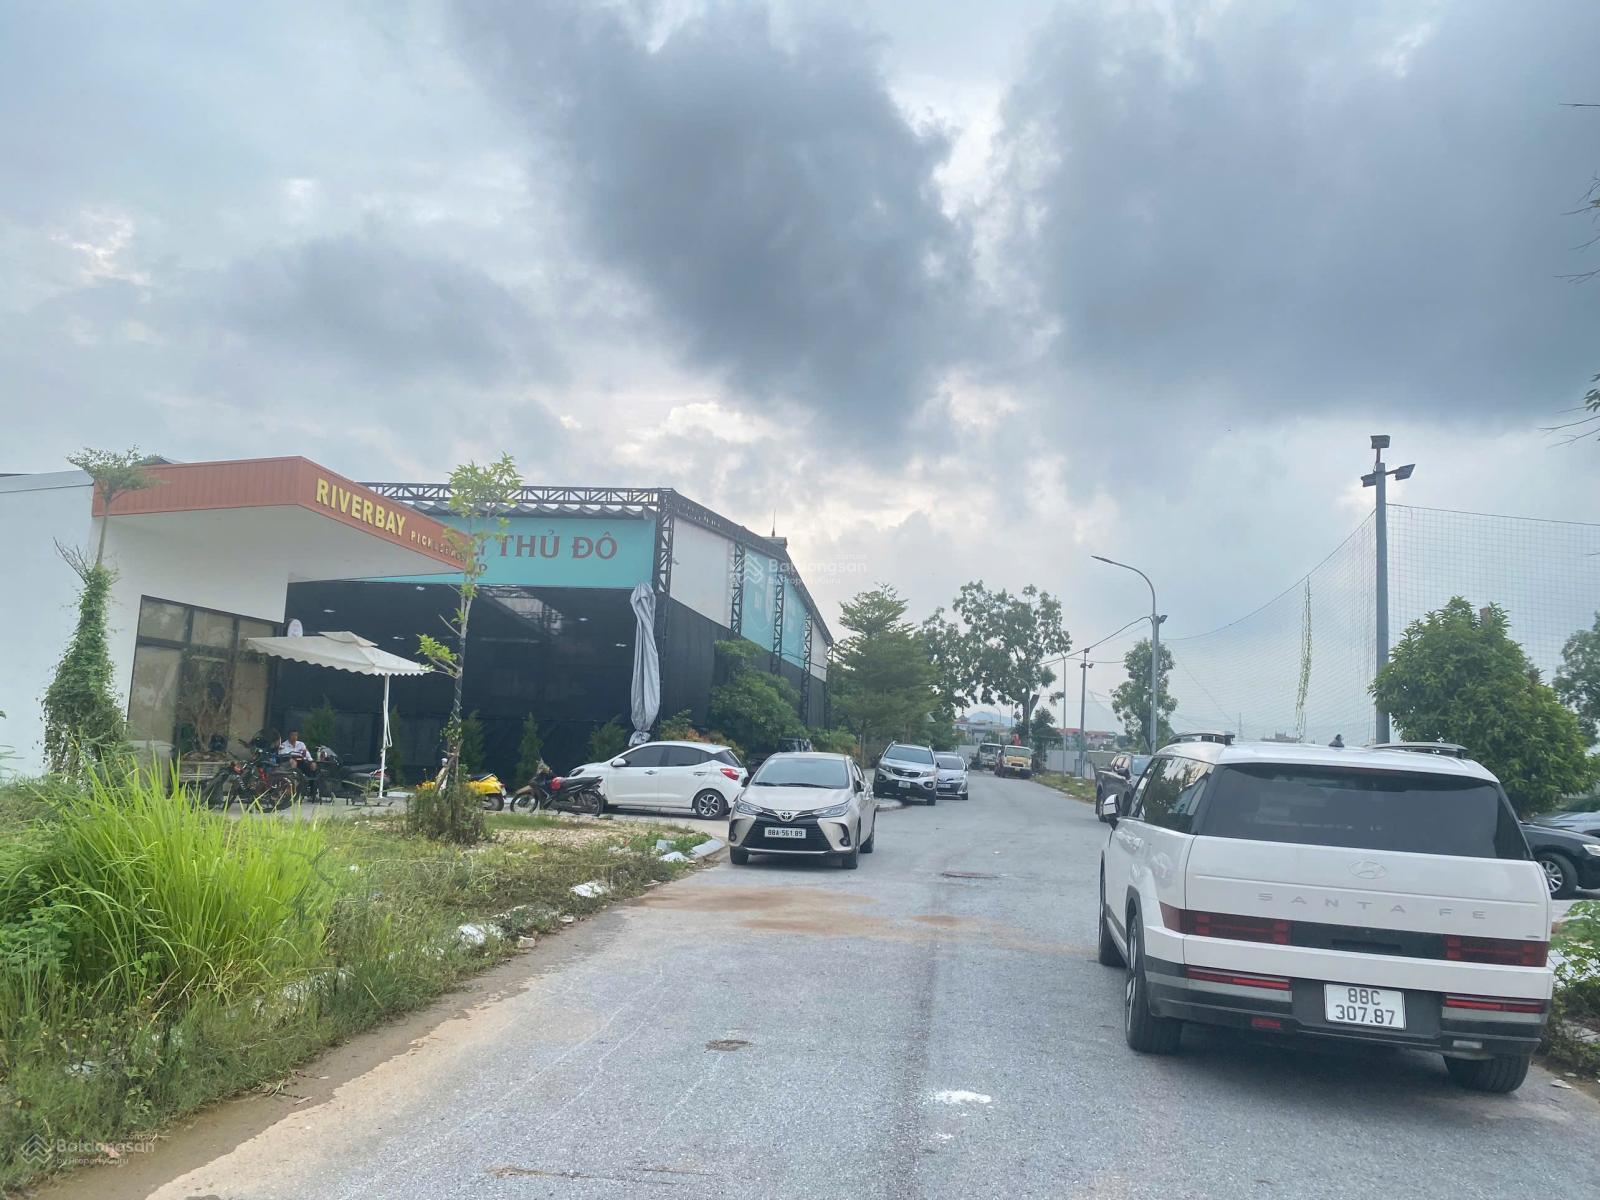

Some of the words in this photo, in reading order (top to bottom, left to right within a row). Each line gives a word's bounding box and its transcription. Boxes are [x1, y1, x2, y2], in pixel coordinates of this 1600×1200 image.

[316, 478, 406, 536] RIVERBAY
[499, 529, 560, 558] THỦ
[572, 531, 617, 560] ĐÔ
[1257, 892, 1406, 914] SANTA
[1438, 907, 1486, 920] FE
[1347, 987, 1382, 1006] 88C
[1335, 1004, 1396, 1025] 307.87
